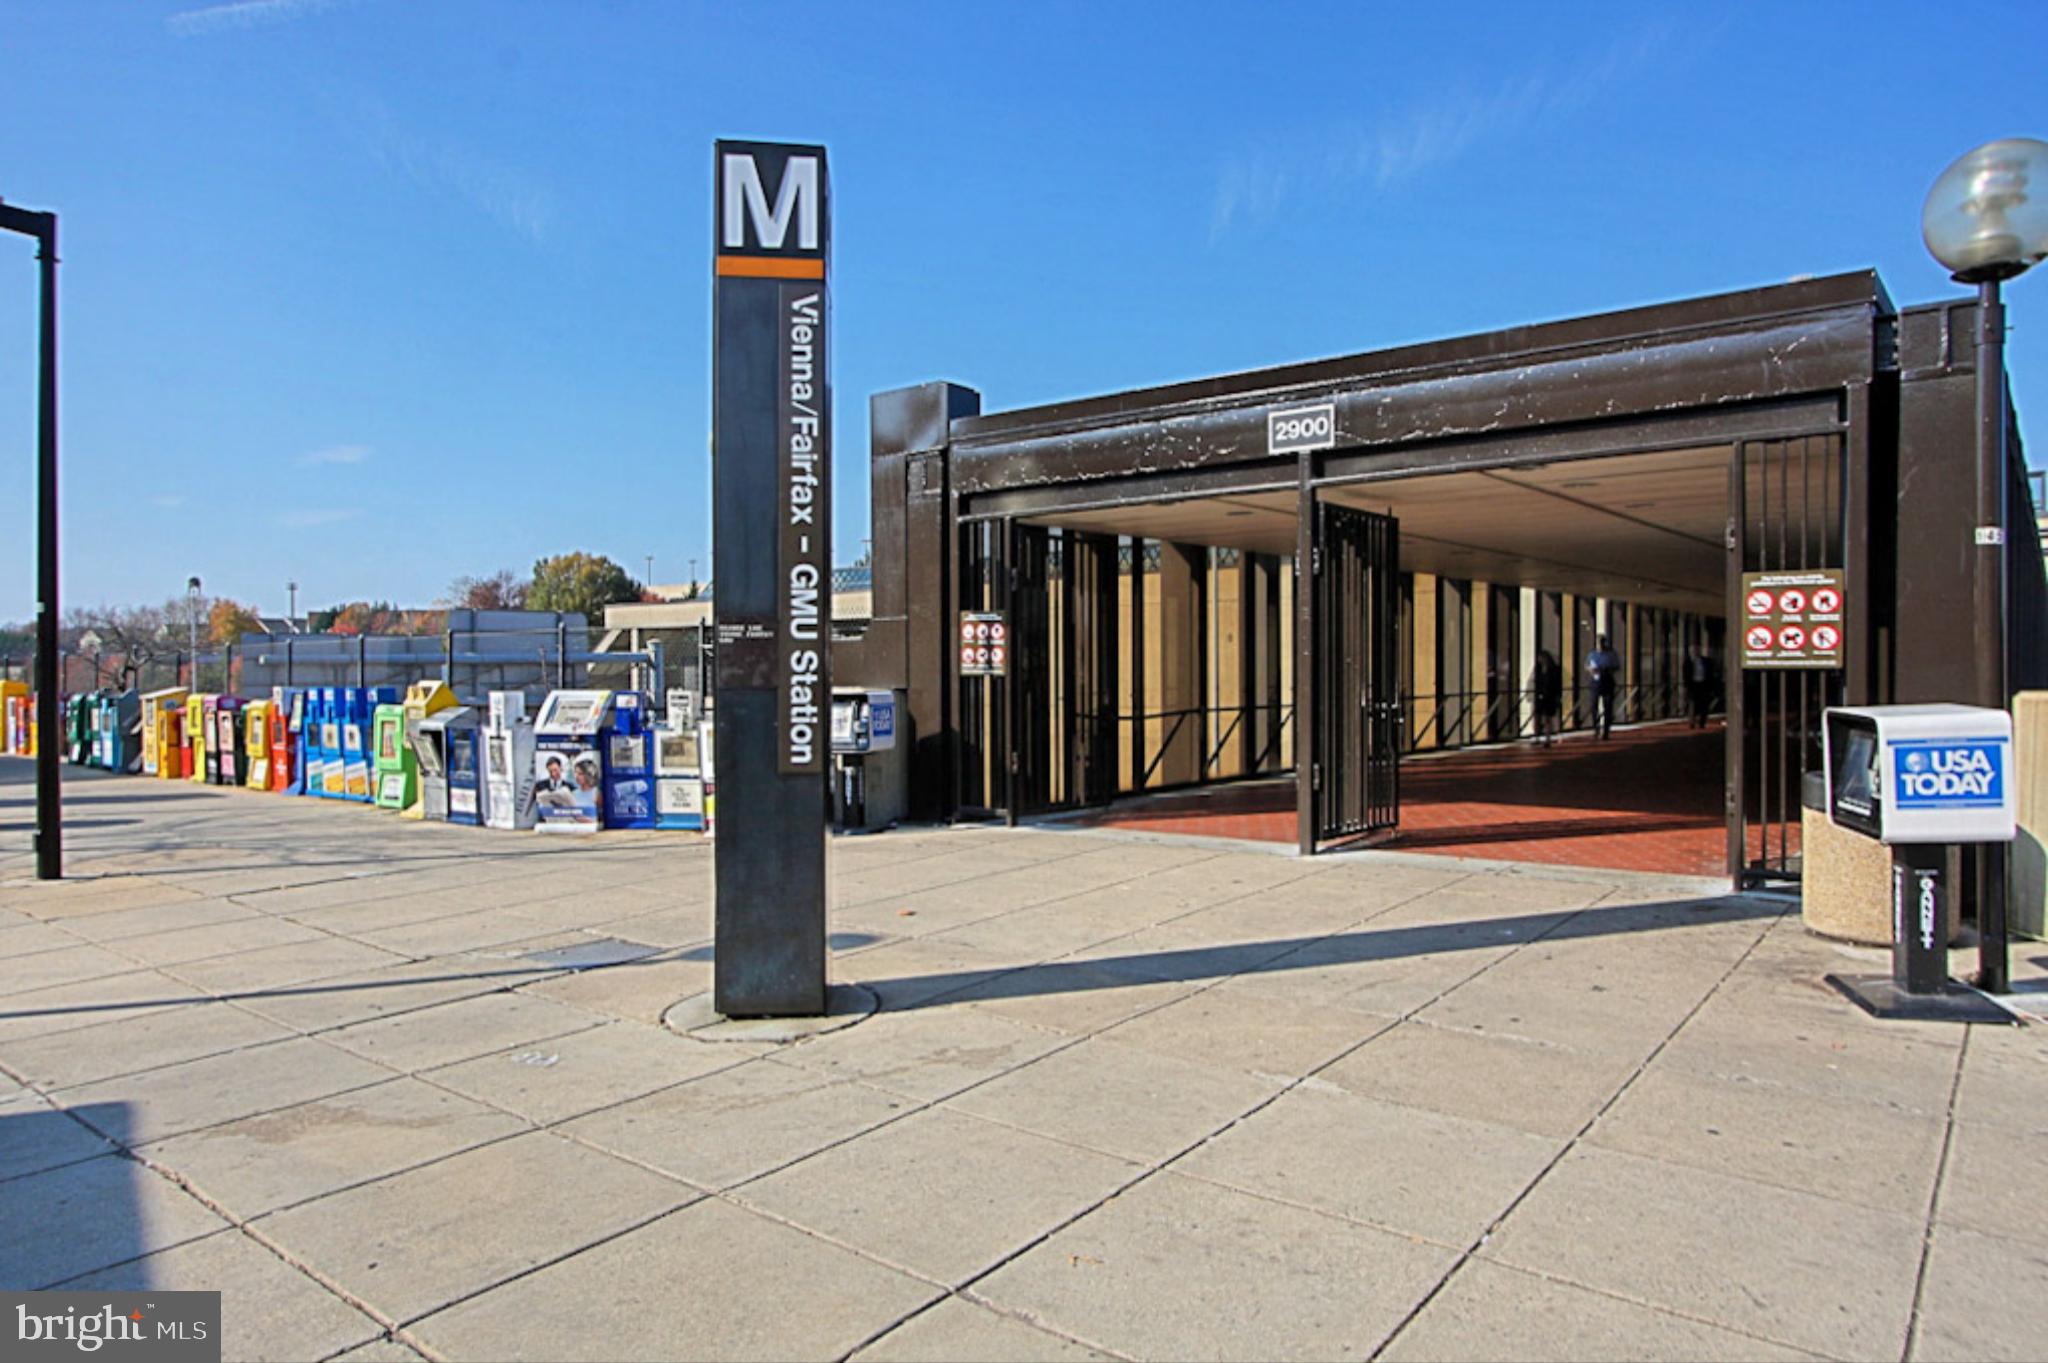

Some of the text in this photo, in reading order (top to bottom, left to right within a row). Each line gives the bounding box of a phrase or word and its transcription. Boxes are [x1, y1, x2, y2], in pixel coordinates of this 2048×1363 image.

[723, 153, 818, 250] M
[790, 294, 820, 525] Vienna/Fairfax
[1276, 416, 1328, 440] 2900
[790, 563, 819, 640] GMU
[790, 649, 820, 765] Station
[1900, 770, 1996, 796] TODAY
[1930, 748, 1993, 772] USA
